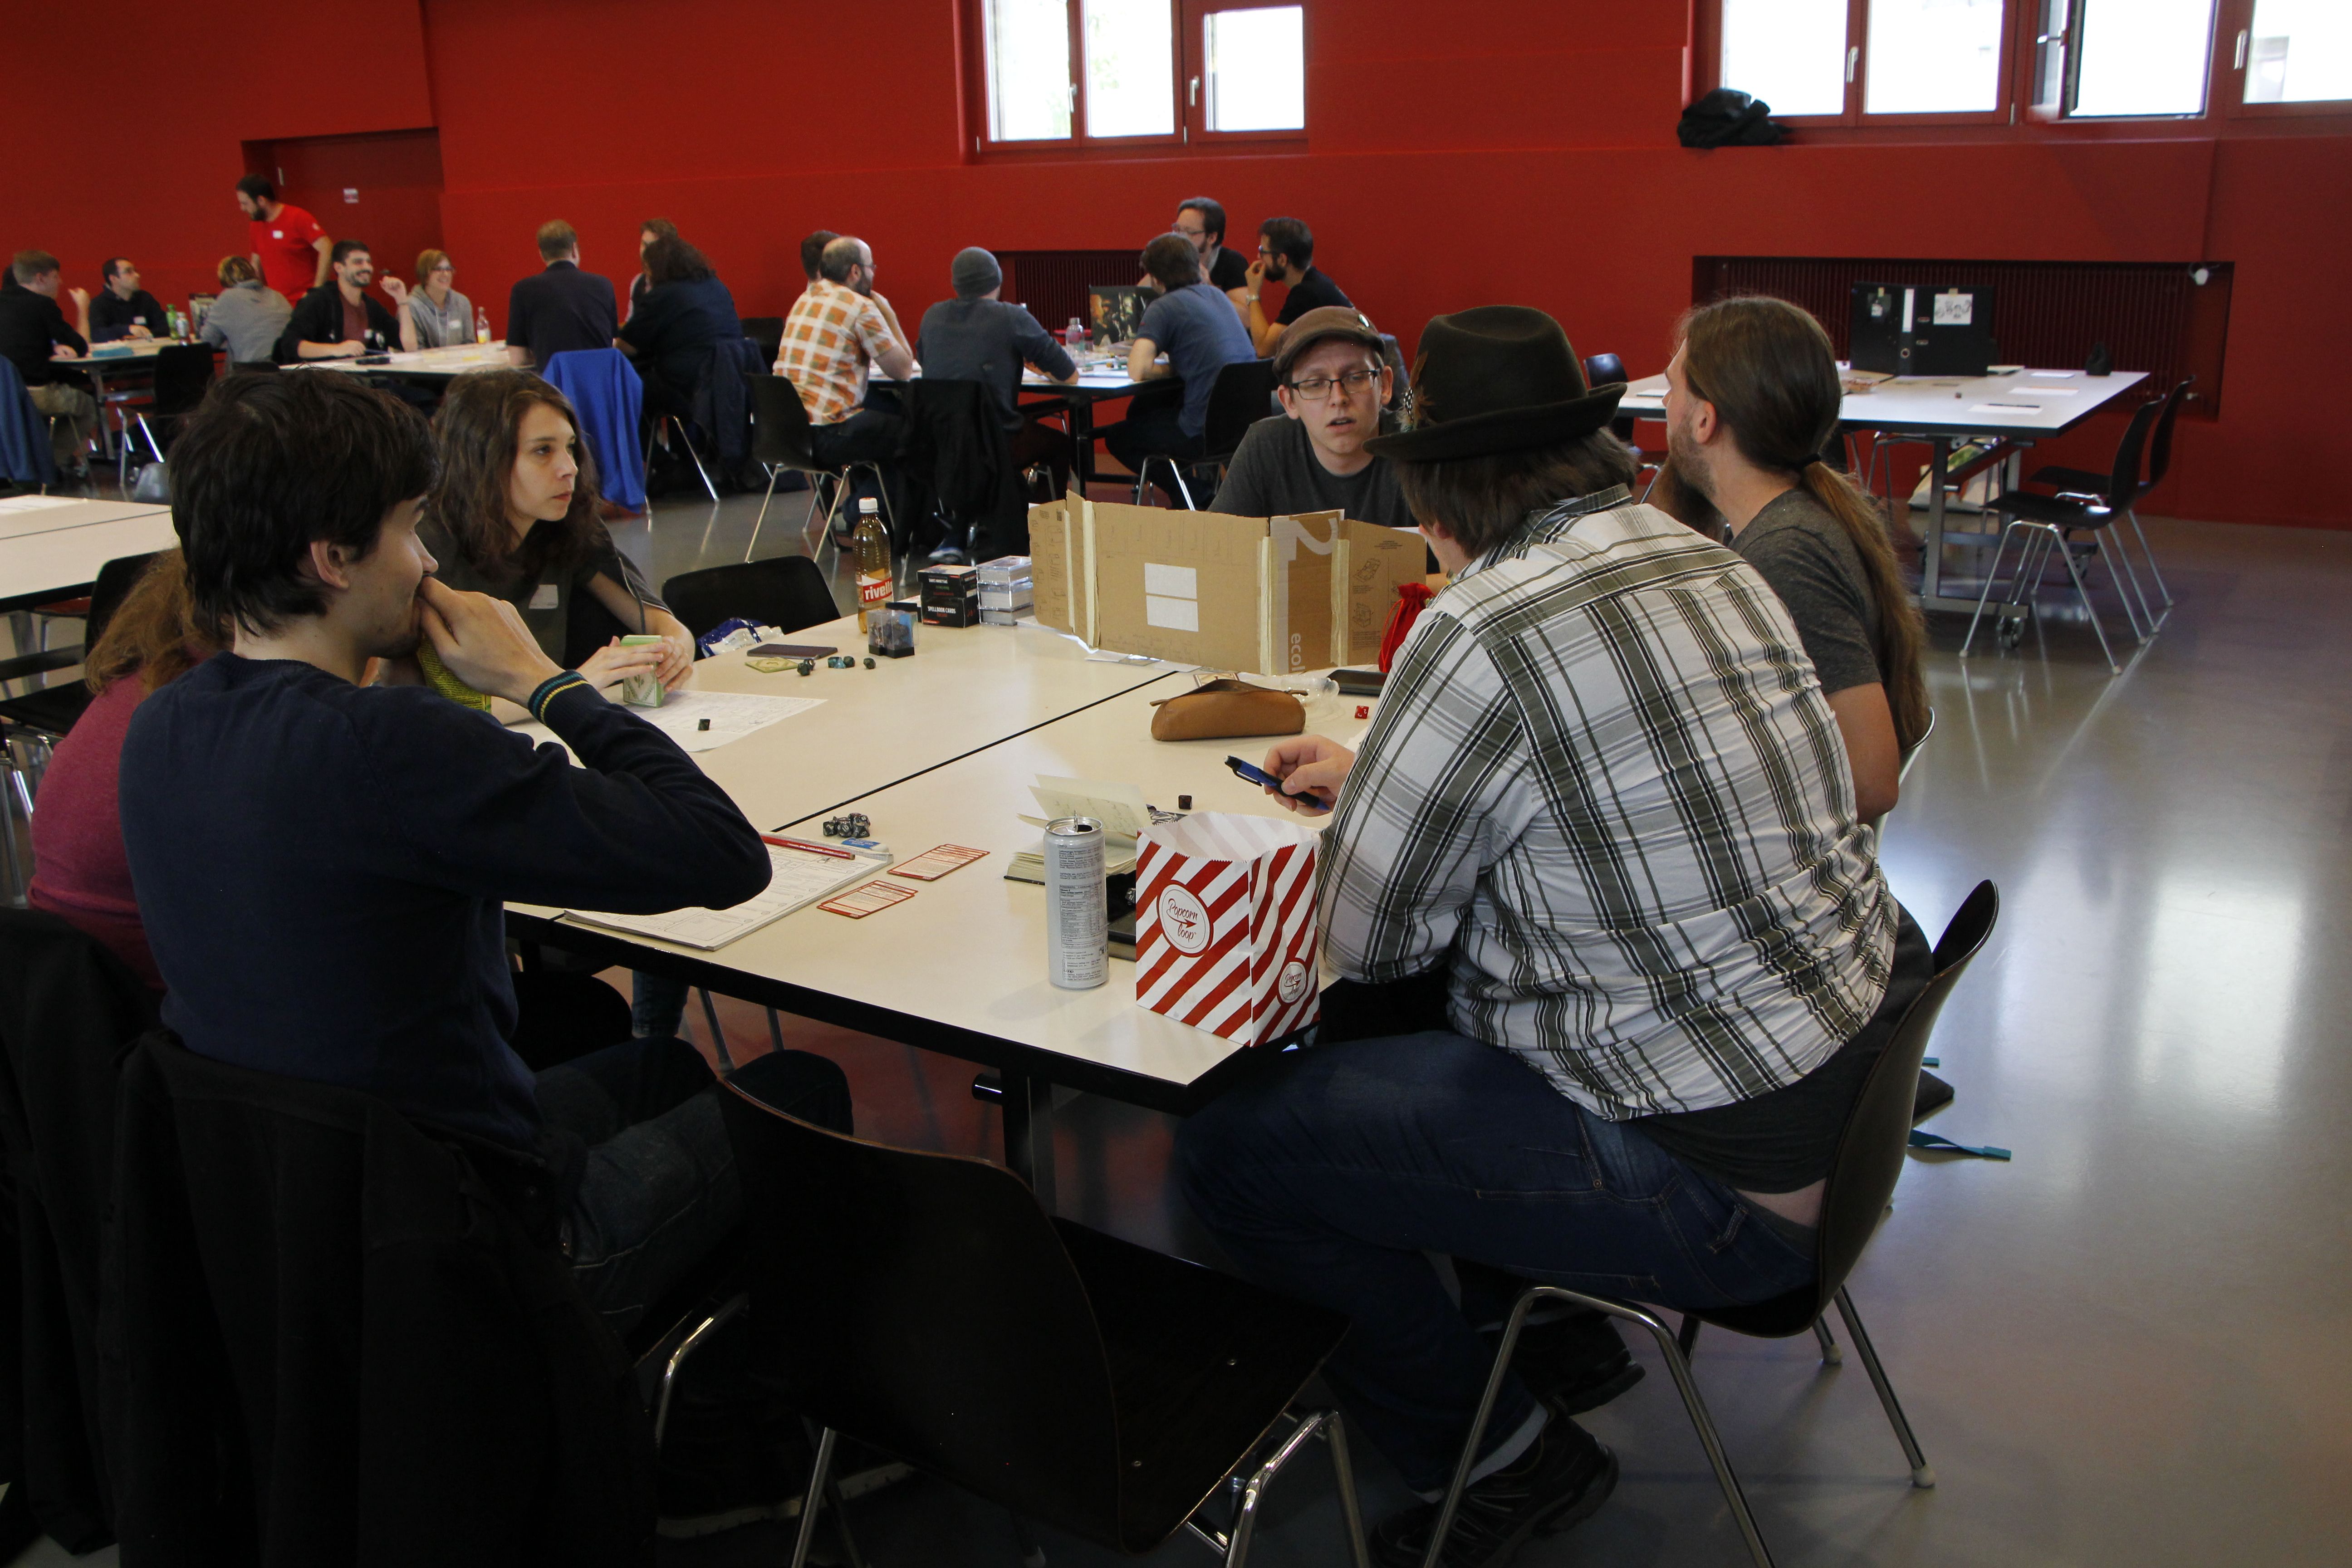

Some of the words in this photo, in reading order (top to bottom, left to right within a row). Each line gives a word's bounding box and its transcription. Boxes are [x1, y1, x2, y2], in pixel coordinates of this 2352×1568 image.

[1291, 632, 1306, 671] ecol
[1168, 898, 1198, 921] Popcorn
[1177, 922, 1194, 943] loop
